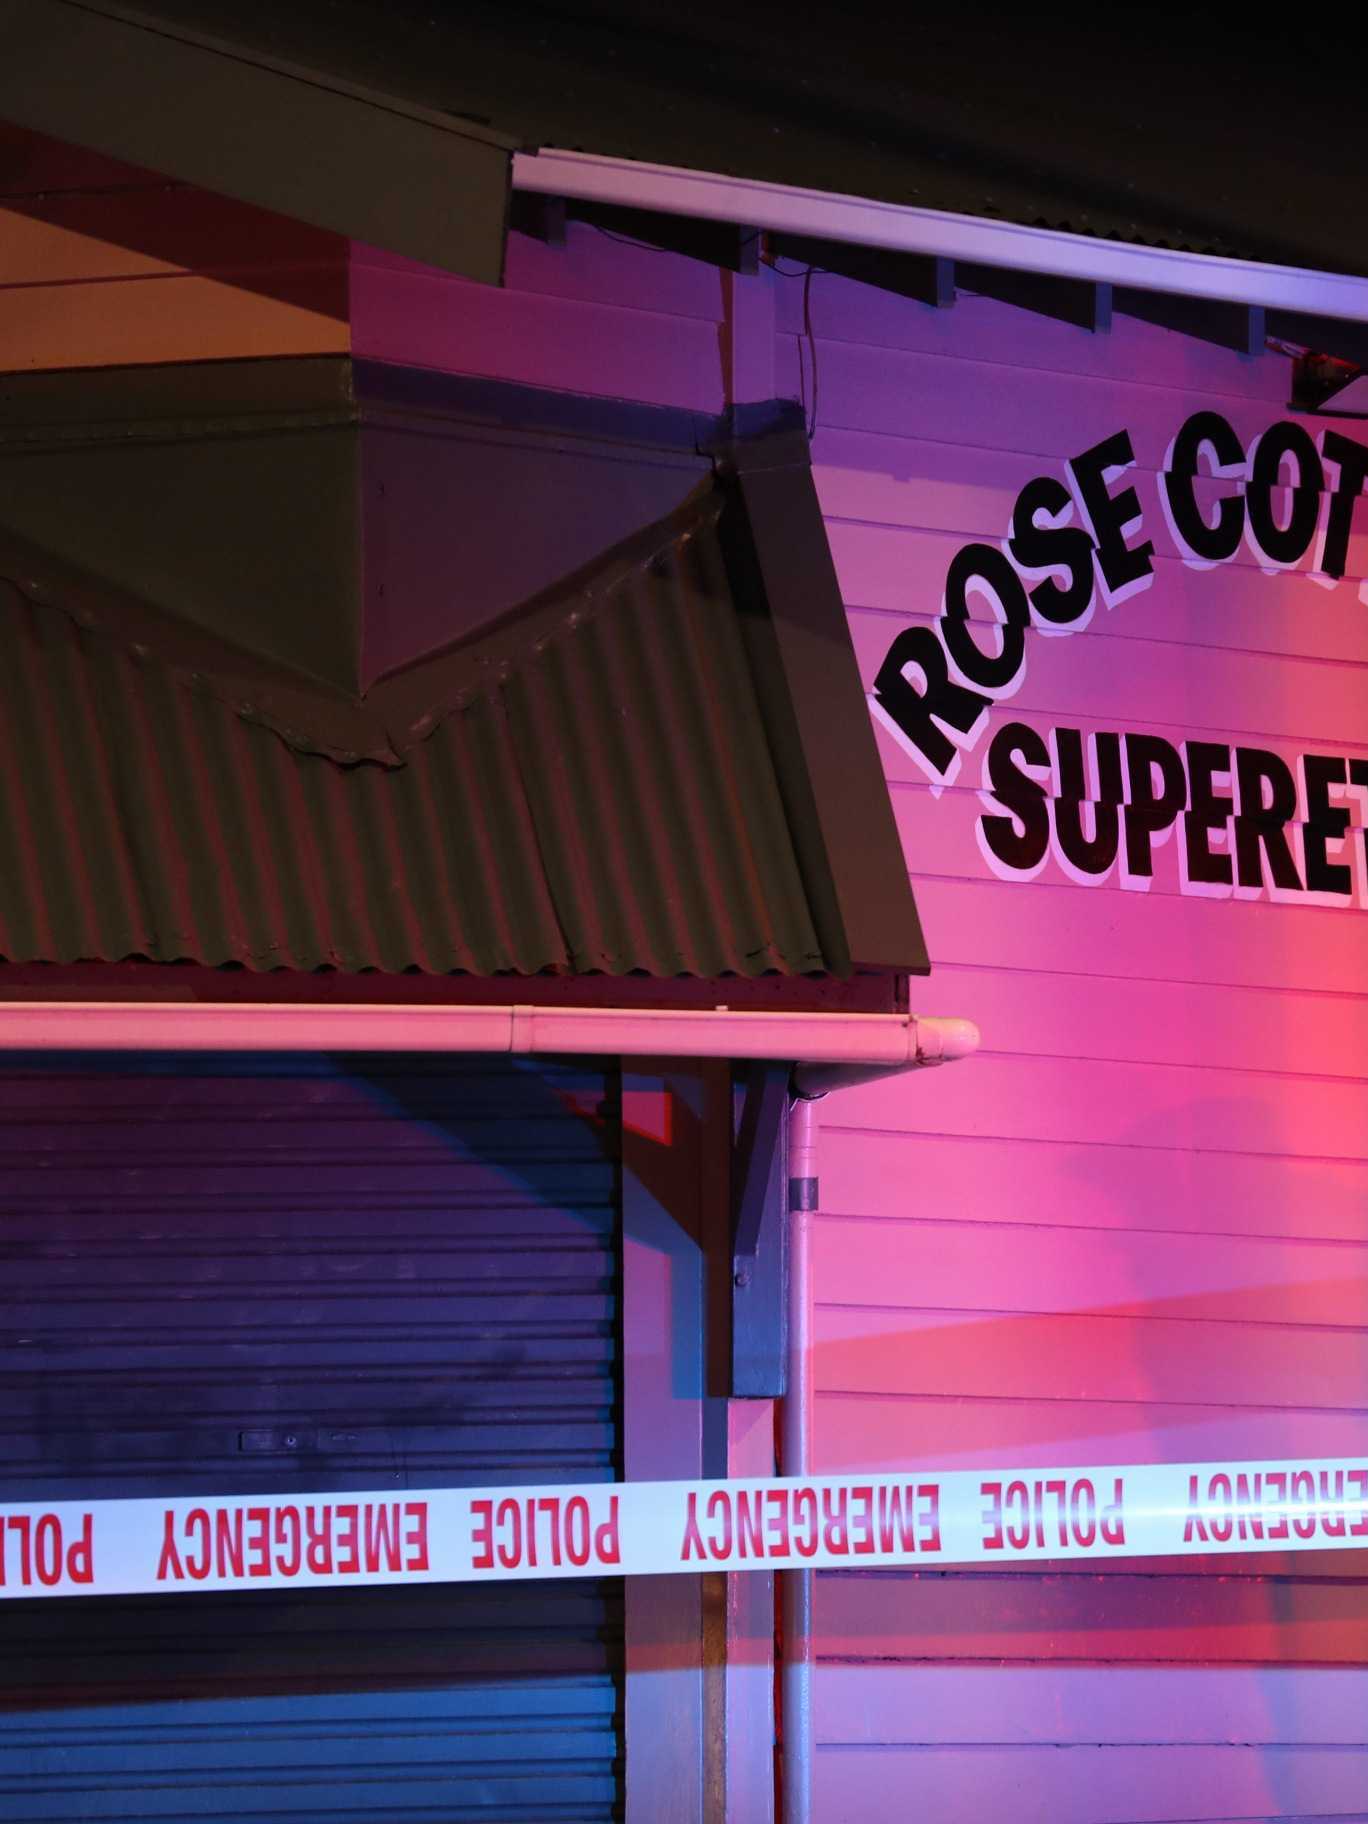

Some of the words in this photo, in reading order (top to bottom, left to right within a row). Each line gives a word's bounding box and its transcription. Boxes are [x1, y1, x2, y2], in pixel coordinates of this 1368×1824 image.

[872, 427, 1156, 777] ROSE
[156, 1502, 430, 1580] EMERGENCY
[471, 1495, 621, 1569] POLICE
[680, 1483, 942, 1561] EMERGENCY
[980, 1478, 1126, 1550] POLICE
